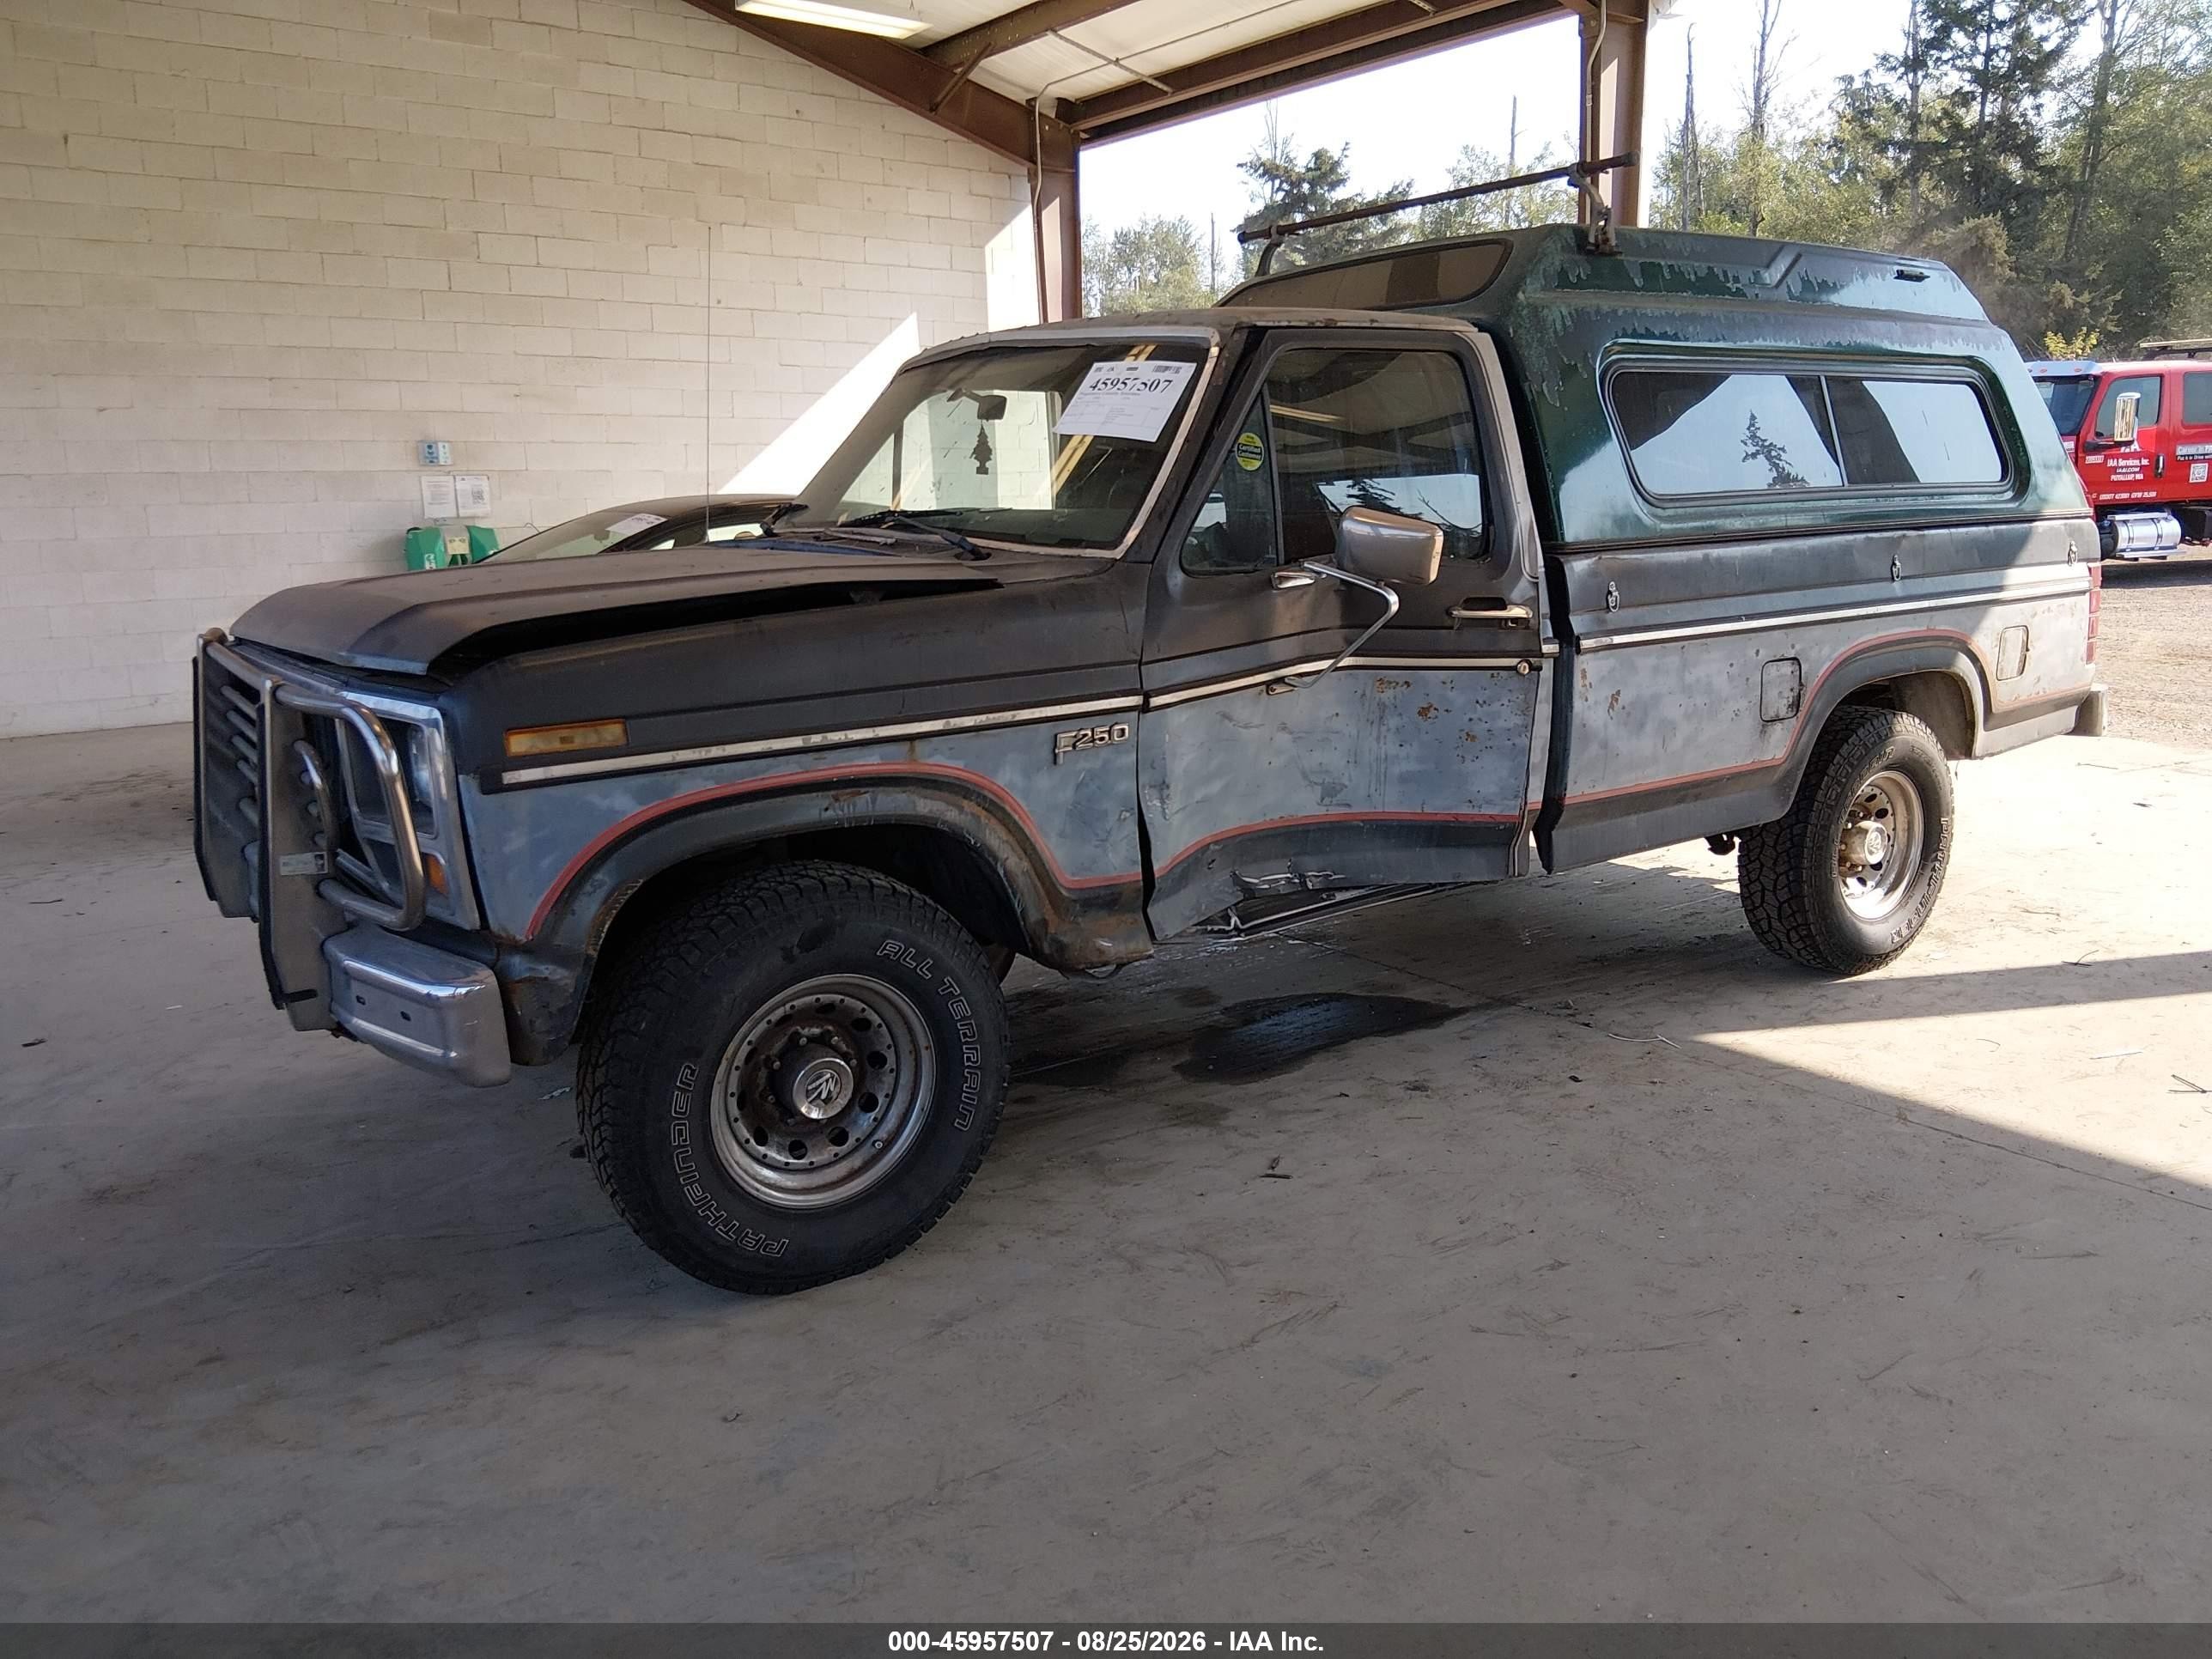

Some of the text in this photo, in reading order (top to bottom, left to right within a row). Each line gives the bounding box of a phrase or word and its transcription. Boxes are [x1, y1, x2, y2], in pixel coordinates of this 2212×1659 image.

[1089, 376, 1173, 393] 45957507
[2107, 458, 2118, 467] IAA
[1054, 723, 1129, 765] F250
[875, 939, 982, 1133] ALL TERRAIN
[670, 1061, 790, 1258] PATHFINDER
